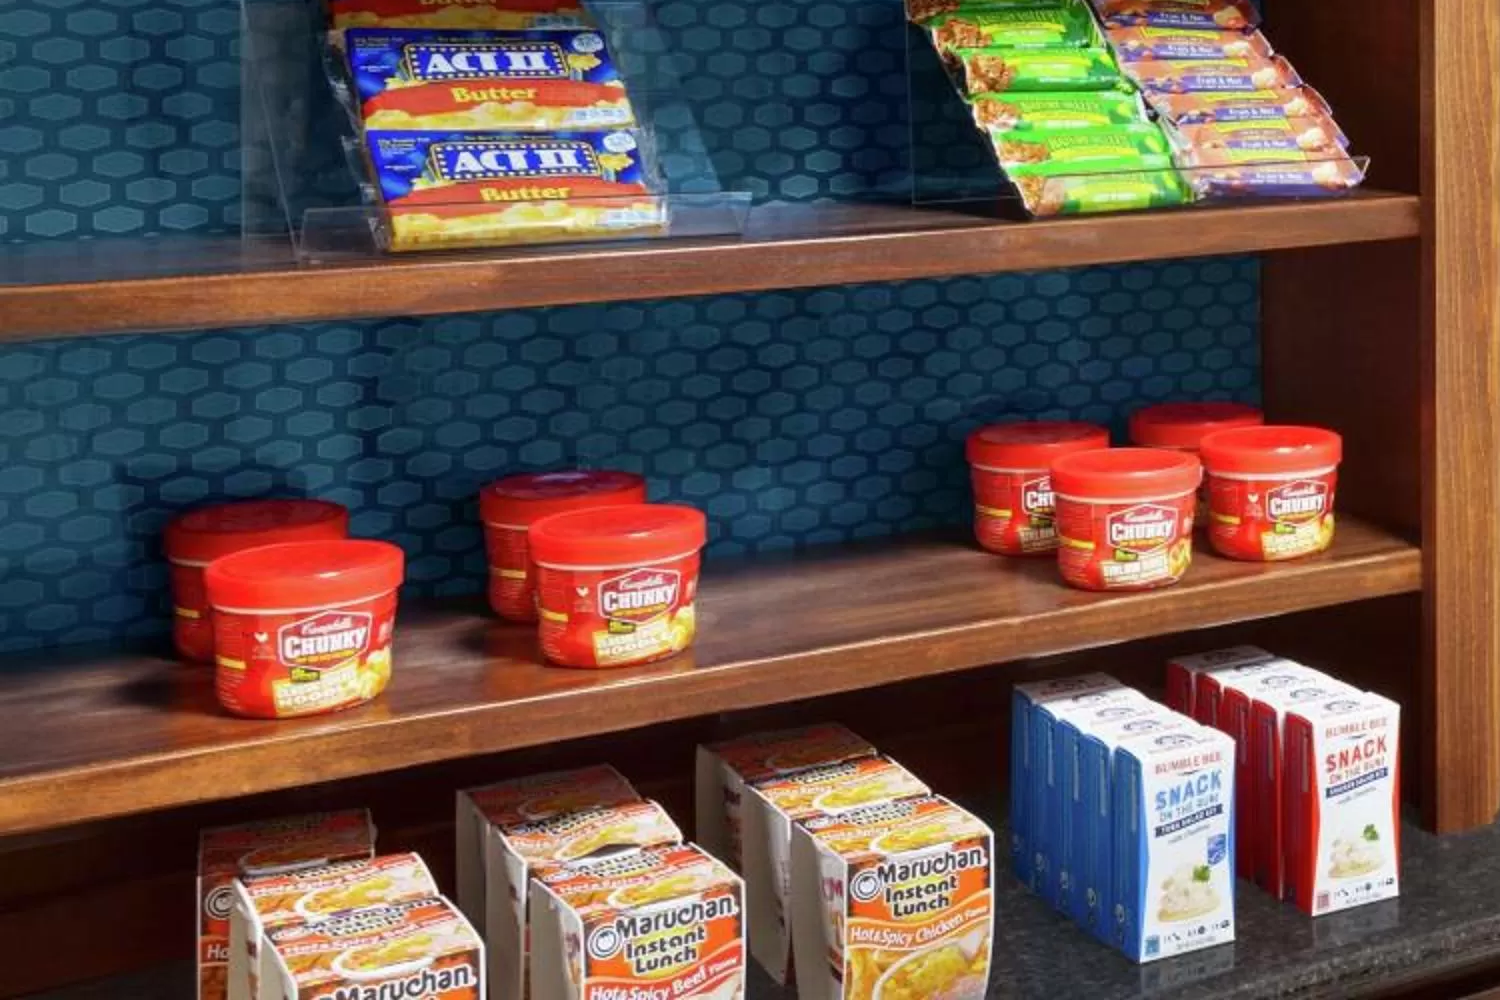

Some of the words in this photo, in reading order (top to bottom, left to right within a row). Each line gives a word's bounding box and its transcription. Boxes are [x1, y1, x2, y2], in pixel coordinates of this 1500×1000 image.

[426, 51, 502, 73] ACT
[504, 51, 550, 71] II
[450, 86, 539, 103] Butter
[454, 150, 533, 172] ACT
[535, 149, 584, 169] II
[480, 185, 572, 203] Butter
[1270, 494, 1325, 516] CHUNKY
[1111, 519, 1173, 541] CHUNKY
[603, 583, 675, 612] CHUNKY
[283, 626, 368, 660] CHUNKY
[1325, 721, 1366, 738] BUMBLE
[1369, 716, 1388, 729] BEE
[1155, 756, 1201, 775] BUMBLE
[1325, 734, 1387, 774] SNACK
[1155, 769, 1222, 811] SNACK
[876, 849, 984, 884] Maruchan
[886, 877, 958, 903] Instant
[615, 896, 735, 940] Maruchan
[893, 894, 950, 919] Lunch
[915, 914, 963, 943] Chicken
[626, 926, 706, 960] Instant
[635, 947, 698, 974] Lunch
[335, 966, 471, 1000] Maruchan
[672, 965, 706, 995] Beef
